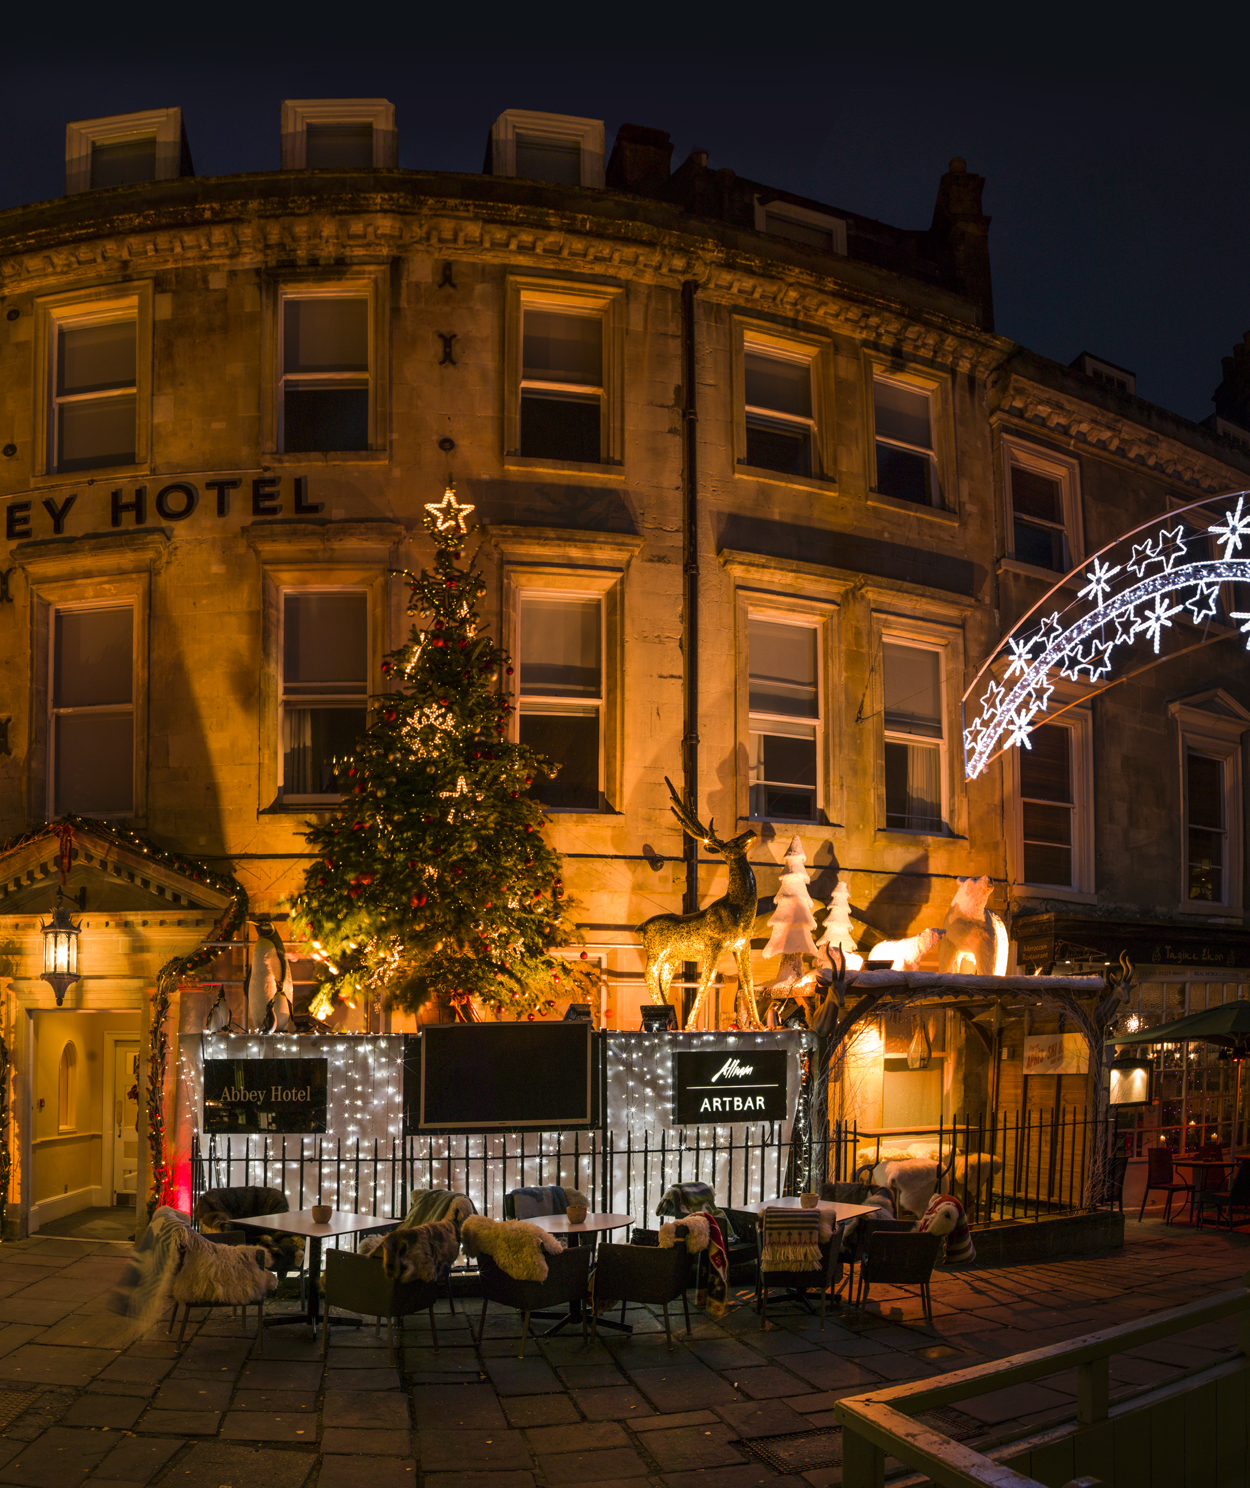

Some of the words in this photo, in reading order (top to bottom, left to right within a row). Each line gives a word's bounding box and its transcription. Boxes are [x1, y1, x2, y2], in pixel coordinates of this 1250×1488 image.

[111, 475, 324, 528] HOTEL
[1164, 945, 1199, 964] Tagine
[220, 1086, 267, 1105] Abbey
[270, 1086, 311, 1102] Hotel
[700, 1096, 765, 1113] ARTBAR
